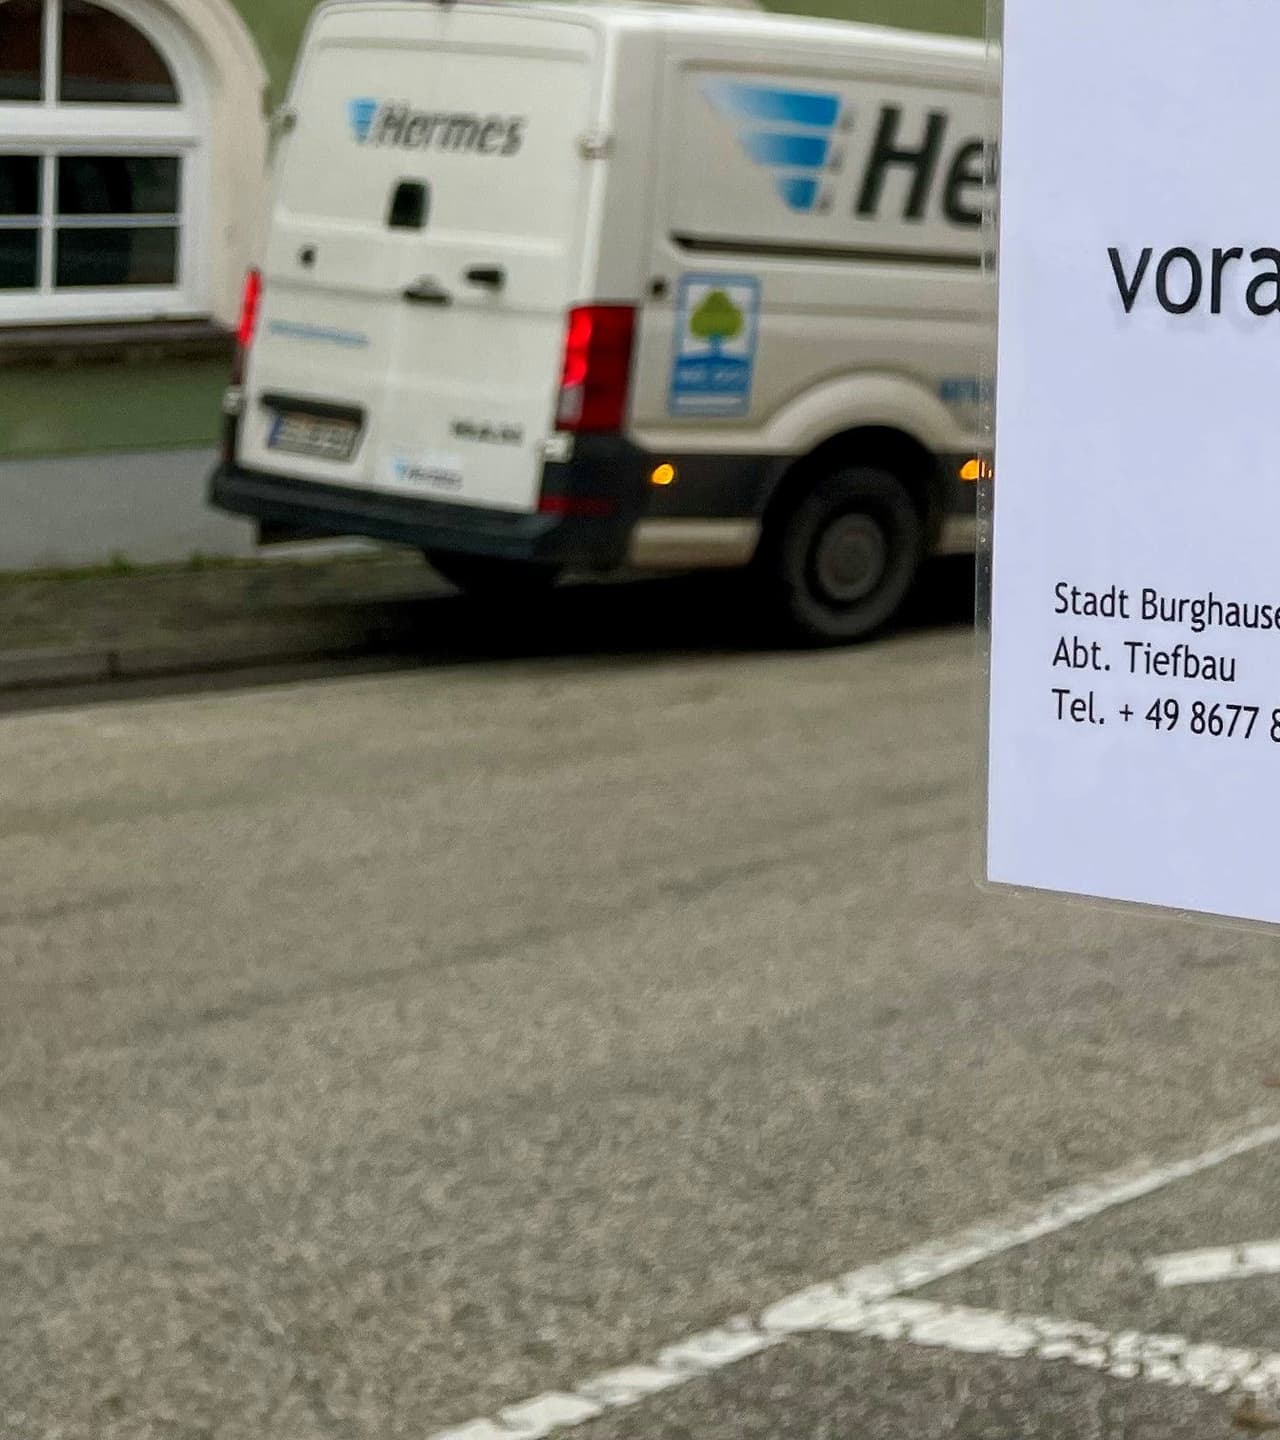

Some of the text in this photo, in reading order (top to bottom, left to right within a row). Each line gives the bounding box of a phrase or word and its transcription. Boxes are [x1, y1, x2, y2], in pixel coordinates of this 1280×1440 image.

[376, 101, 525, 158] Hermes
[1054, 581, 1130, 619] Stadt
[1052, 635, 1237, 682] Abt. Tiefbau
[1051, 687, 1105, 725] Tel.
[1118, 703, 1135, 722] +
[1144, 697, 1180, 732] 49
[1190, 700, 1260, 739] 8677
